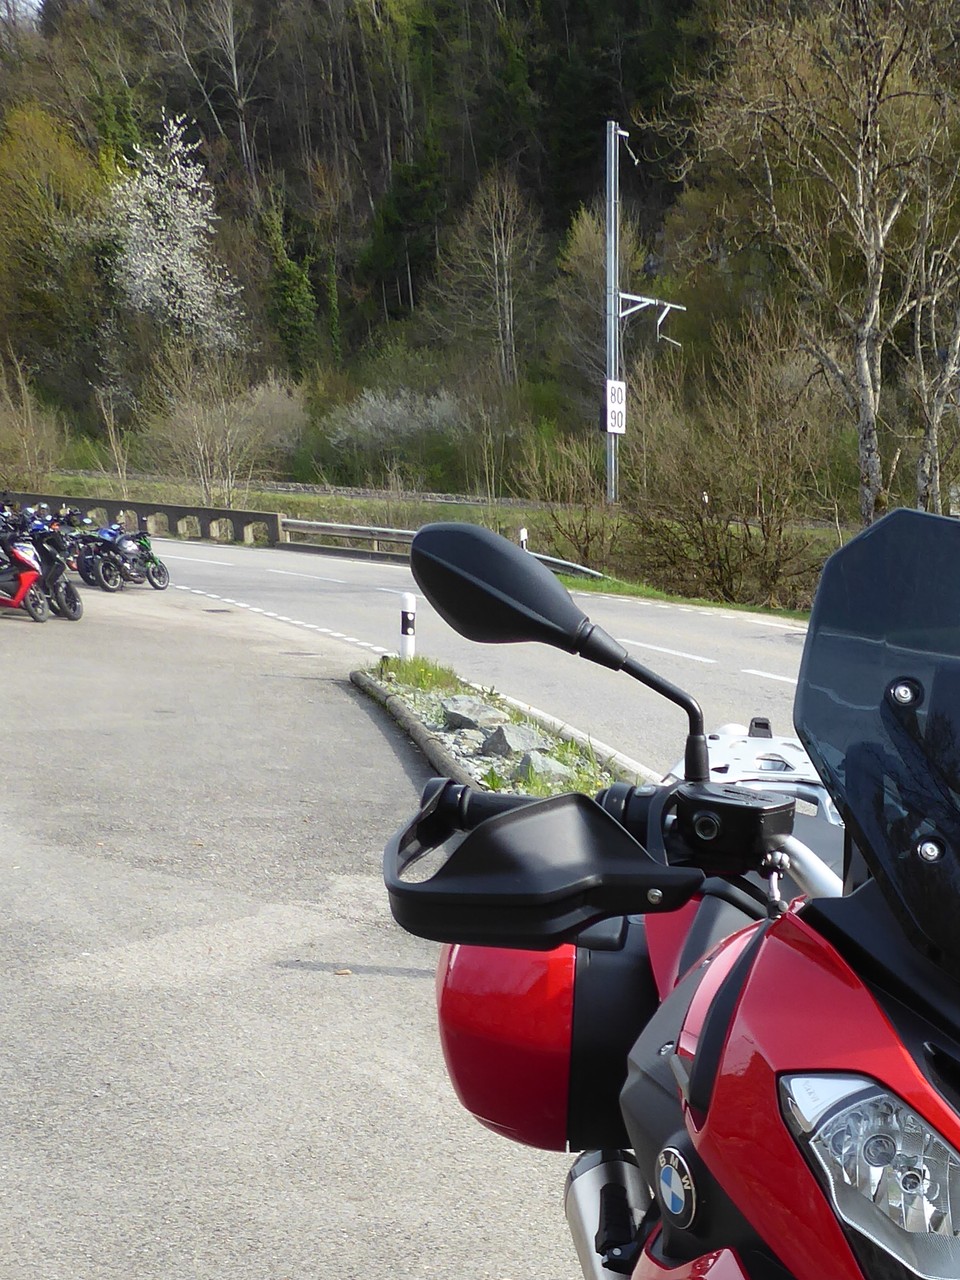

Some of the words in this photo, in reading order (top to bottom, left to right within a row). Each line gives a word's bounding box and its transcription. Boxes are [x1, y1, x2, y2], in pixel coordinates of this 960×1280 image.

[610, 386, 624, 405] 80
[610, 410, 624, 428] 90
[659, 1153, 692, 1190] BMW
